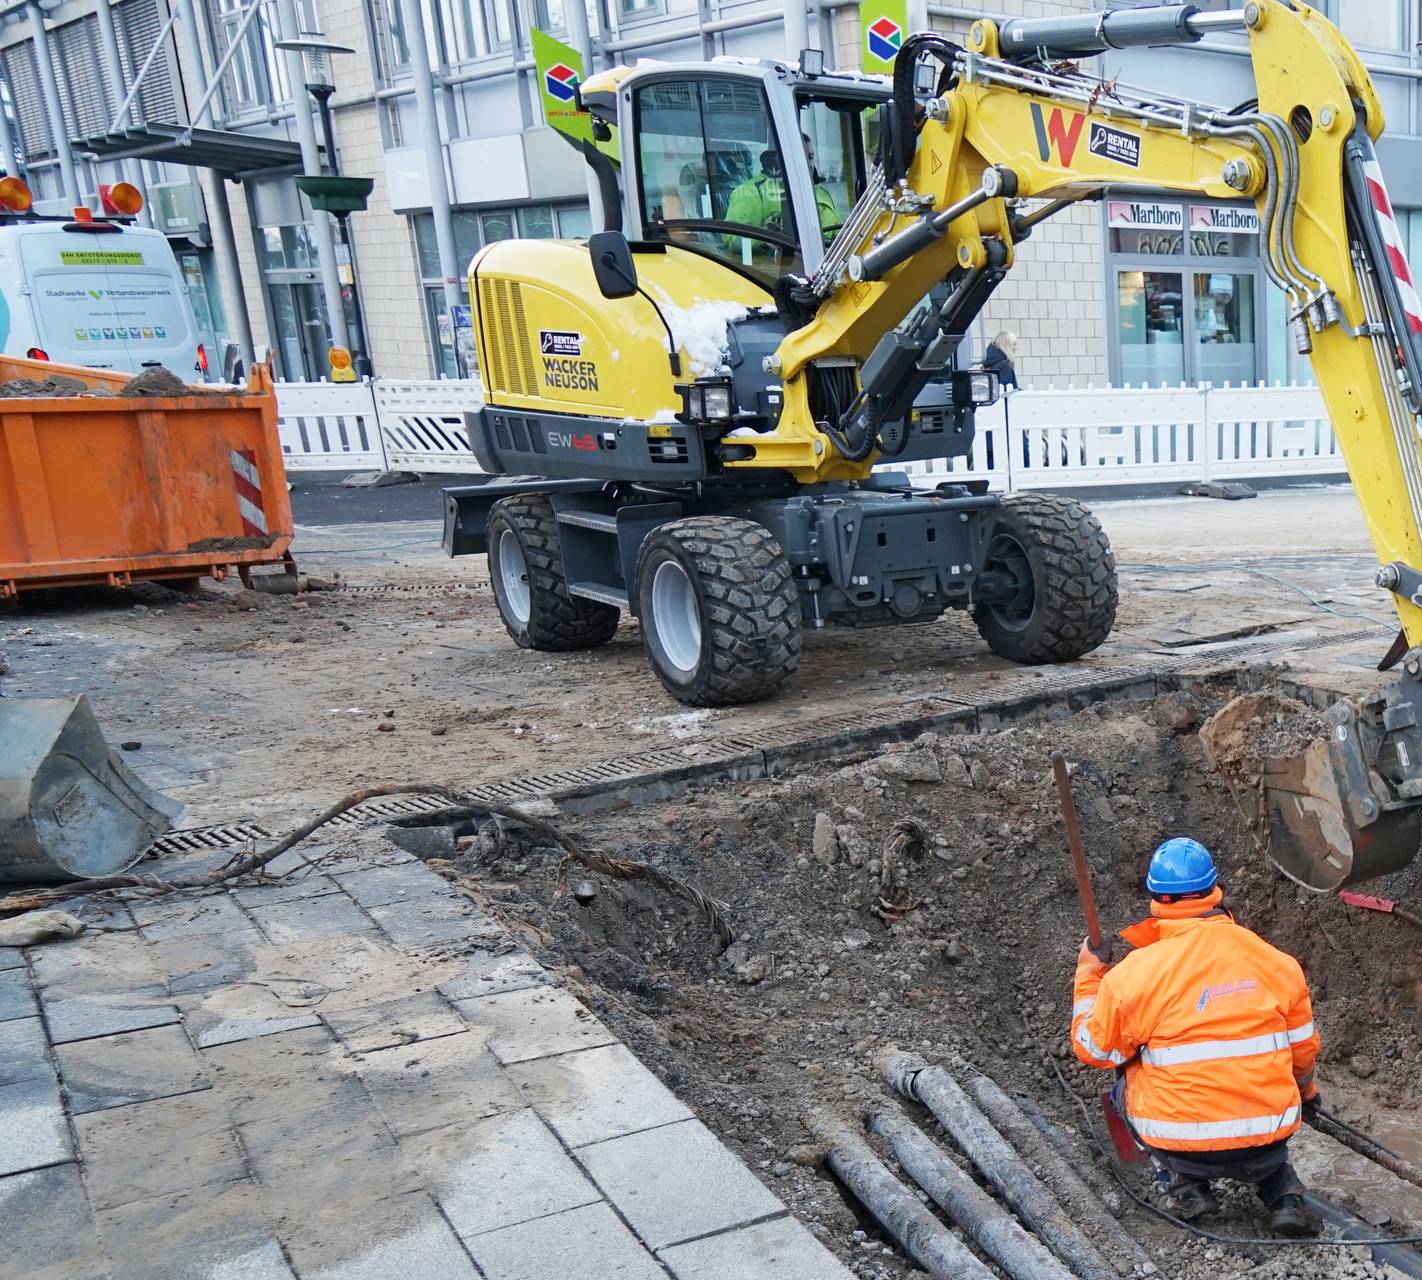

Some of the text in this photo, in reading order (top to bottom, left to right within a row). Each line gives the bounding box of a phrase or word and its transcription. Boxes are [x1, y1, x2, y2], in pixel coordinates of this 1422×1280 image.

[1107, 133, 1138, 153] RENTAL
[1130, 204, 1181, 226] Marlboro
[1210, 208, 1257, 229] Marlboro
[553, 335, 579, 345] RENTAL
[542, 357, 597, 376] WACKER
[544, 372, 599, 391] NEUSON
